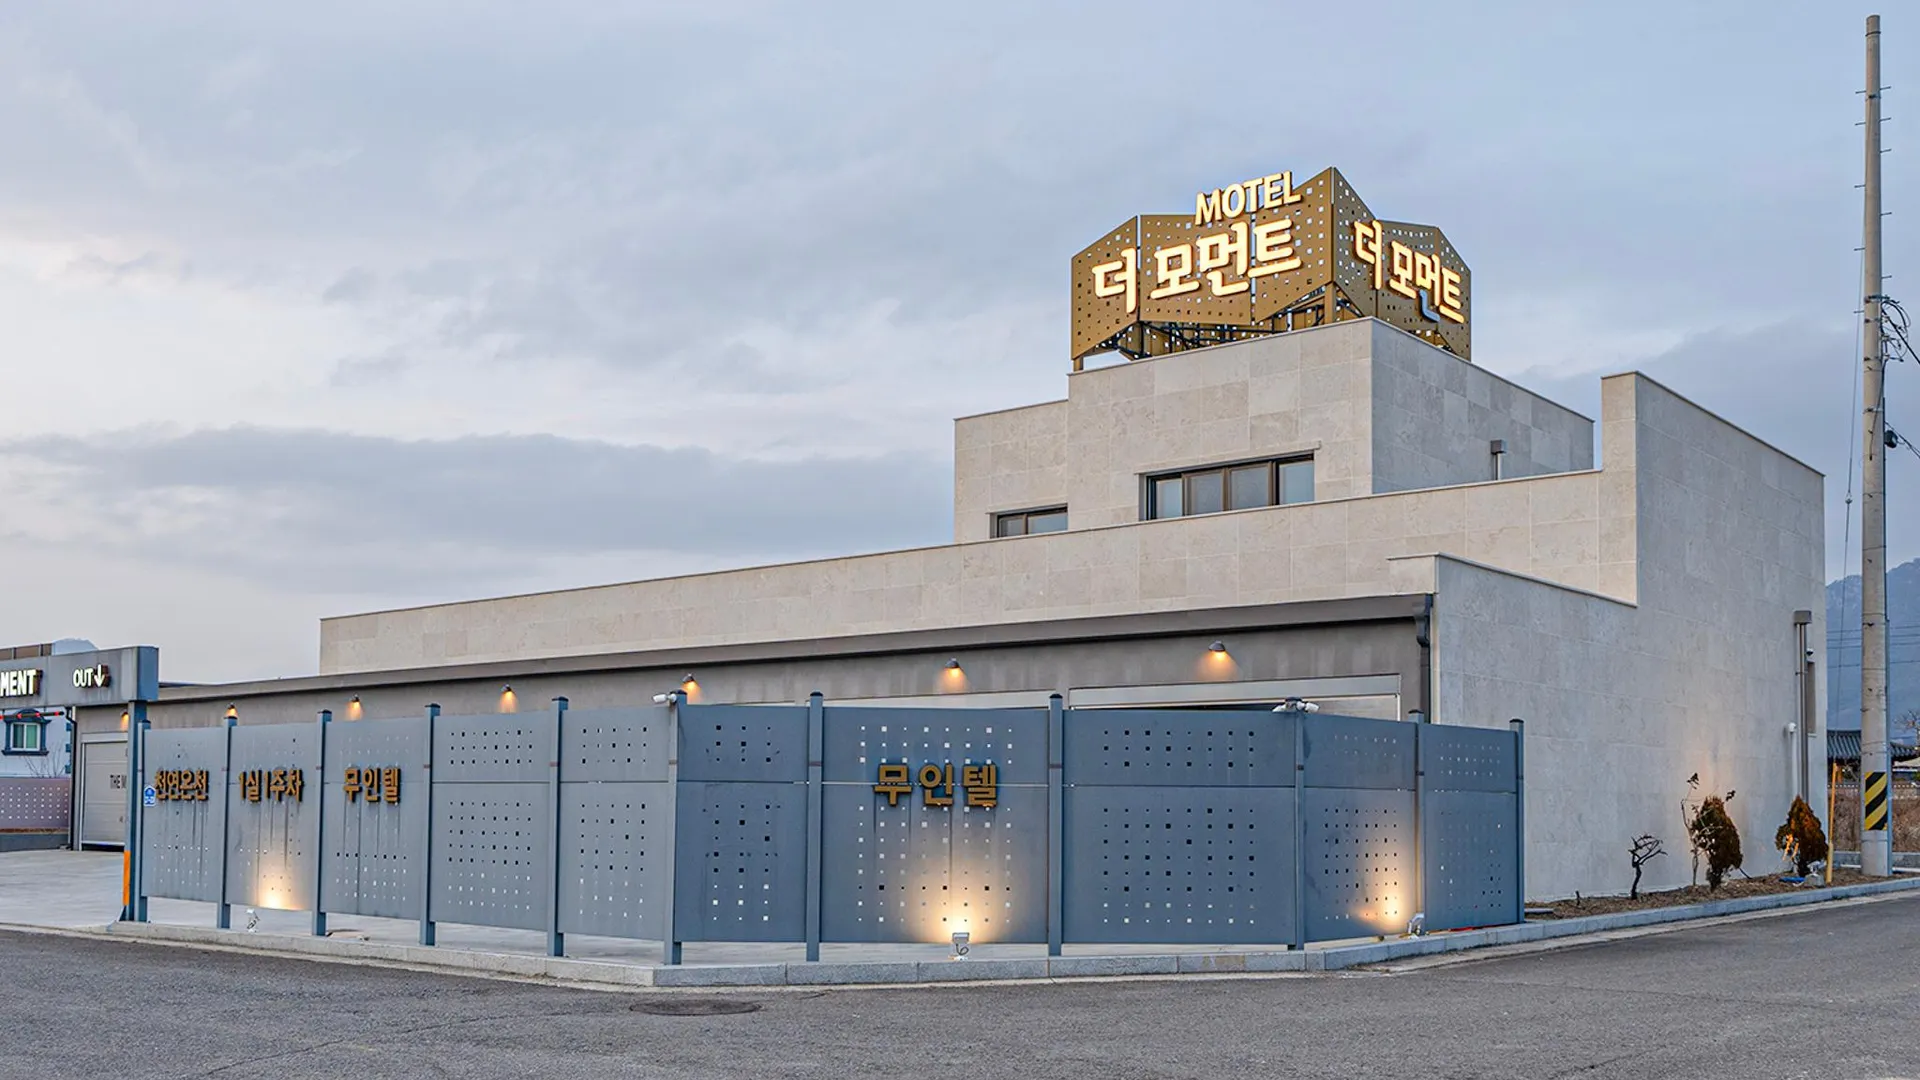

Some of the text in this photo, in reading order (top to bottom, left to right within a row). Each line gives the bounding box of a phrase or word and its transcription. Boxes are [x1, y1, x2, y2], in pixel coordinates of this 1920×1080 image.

[1195, 171, 1302, 226] MOTEL
[1091, 219, 1302, 314] 더 모먼트
[1353, 219, 1465, 324] 더 모먼트
[0, 669, 37, 697] MENT
[73, 667, 94, 688] OUT
[343, 767, 400, 802] 무인텔
[873, 763, 998, 807] 무인텔
